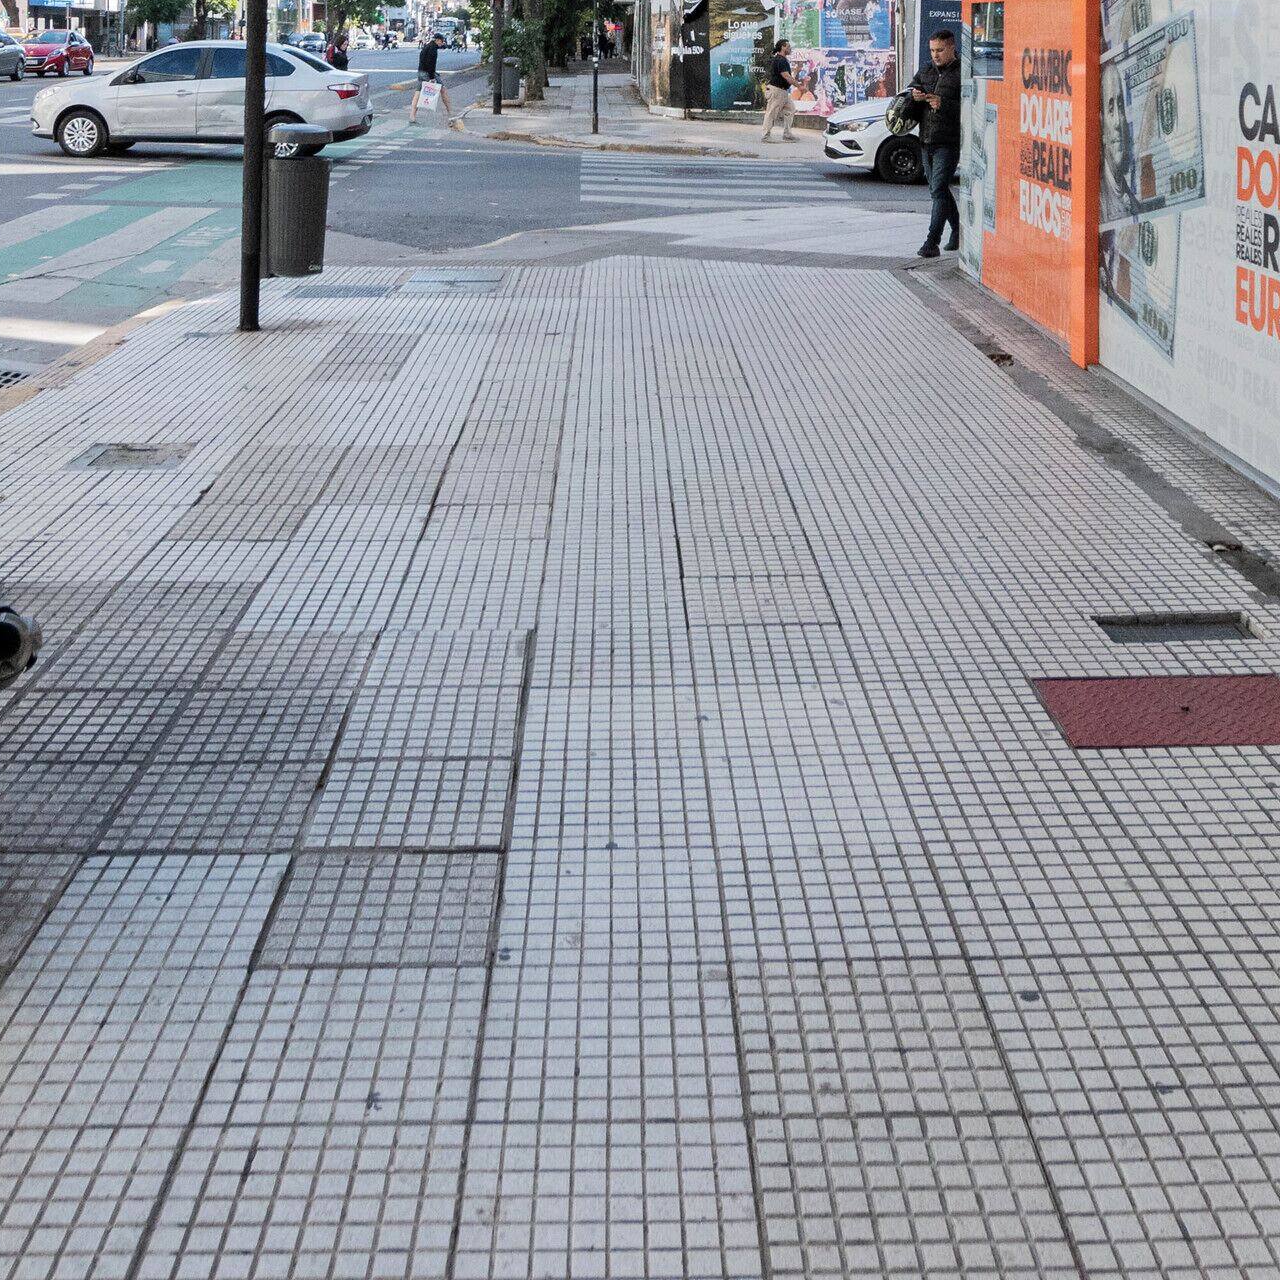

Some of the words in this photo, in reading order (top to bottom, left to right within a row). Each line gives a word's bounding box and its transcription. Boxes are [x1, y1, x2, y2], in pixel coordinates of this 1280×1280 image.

[727, 19, 739, 29] Lo
[740, 21, 758, 30] que
[1169, 169, 1198, 196] 100
[1020, 179, 1062, 238] EUROS
[1236, 205, 1263, 229] REALES
[1236, 223, 1263, 249] REALES
[1236, 243, 1263, 267] REALES
[1142, 303, 1169, 341] 100
